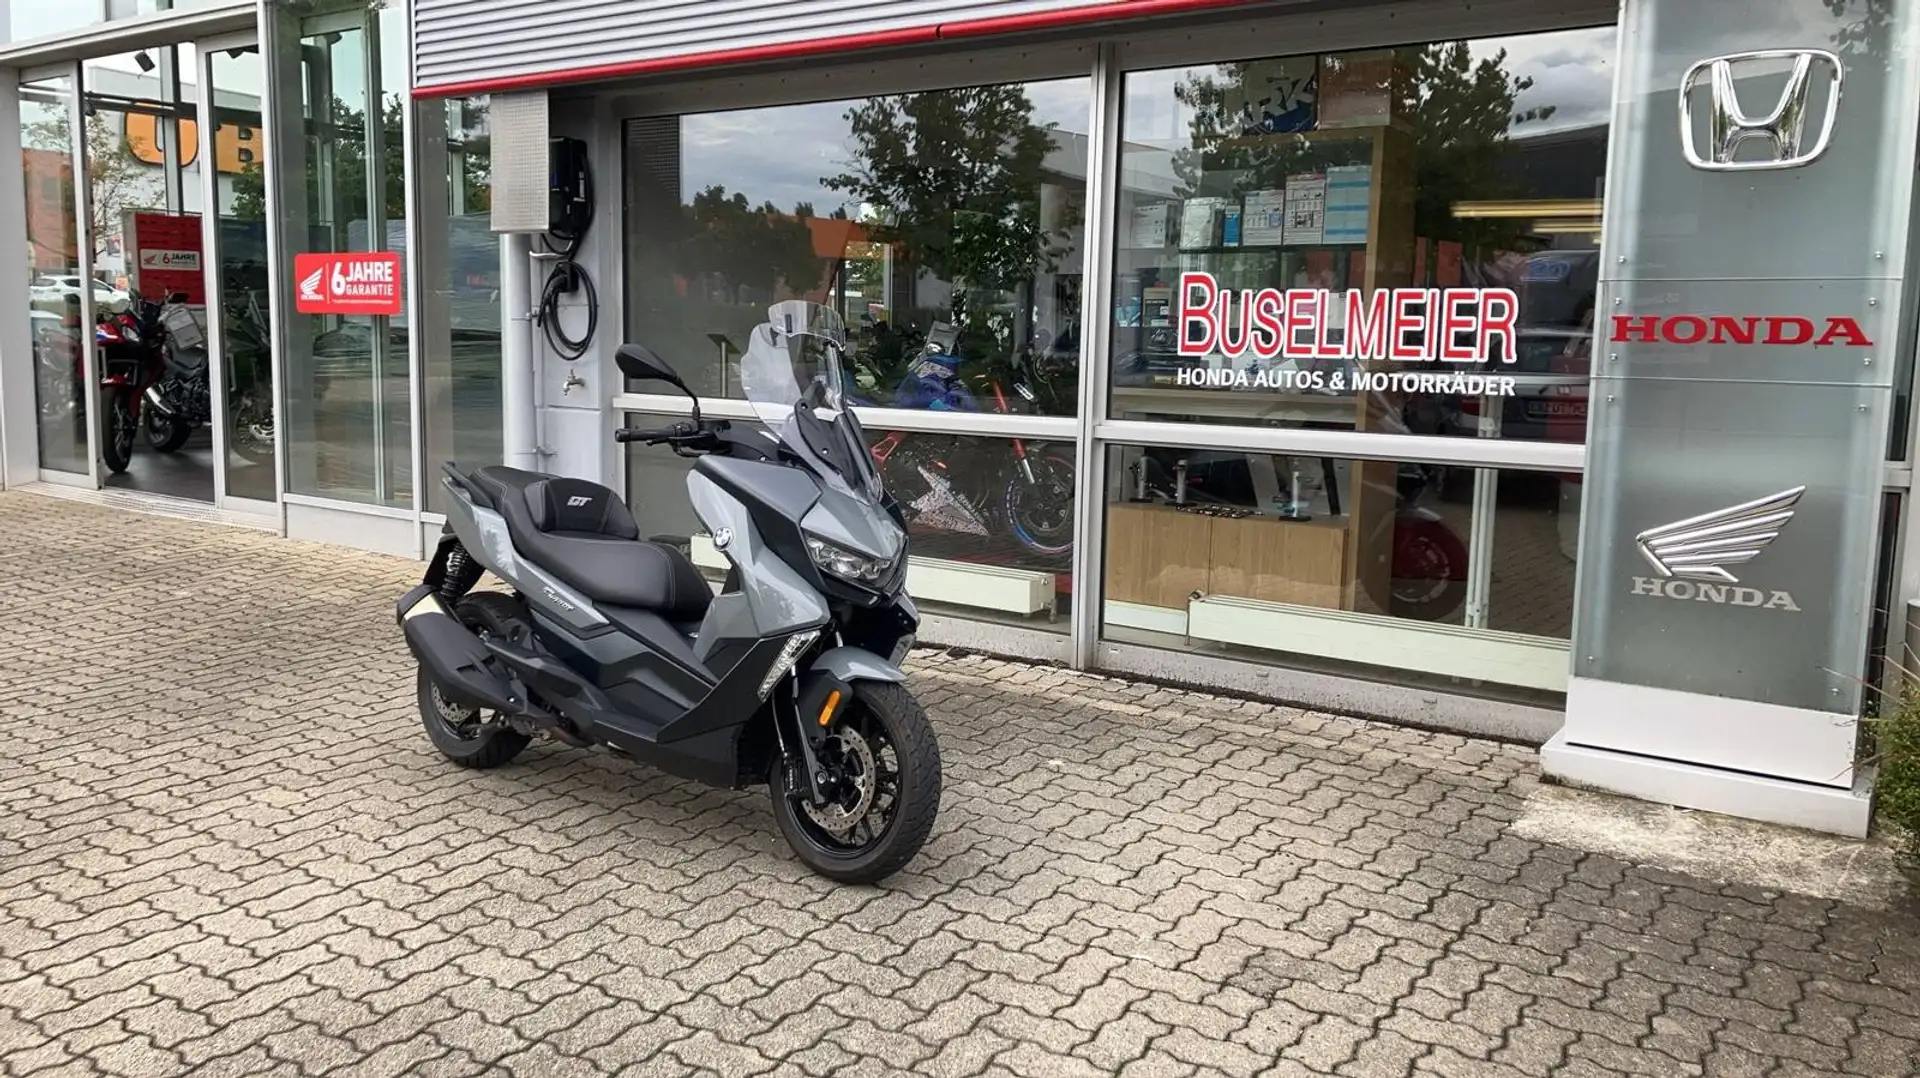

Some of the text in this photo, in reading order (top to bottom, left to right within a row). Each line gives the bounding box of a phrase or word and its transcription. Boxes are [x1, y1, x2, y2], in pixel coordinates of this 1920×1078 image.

[163, 252, 170, 264] 6
[331, 261, 395, 296] 6 JAHRE
[345, 283, 394, 296] GARANTIE
[1610, 316, 1874, 346] HONDA
[1177, 367, 1516, 396] HONDA AUTOS & MOTORRÄDER
[1630, 576, 1802, 612] HONDA
